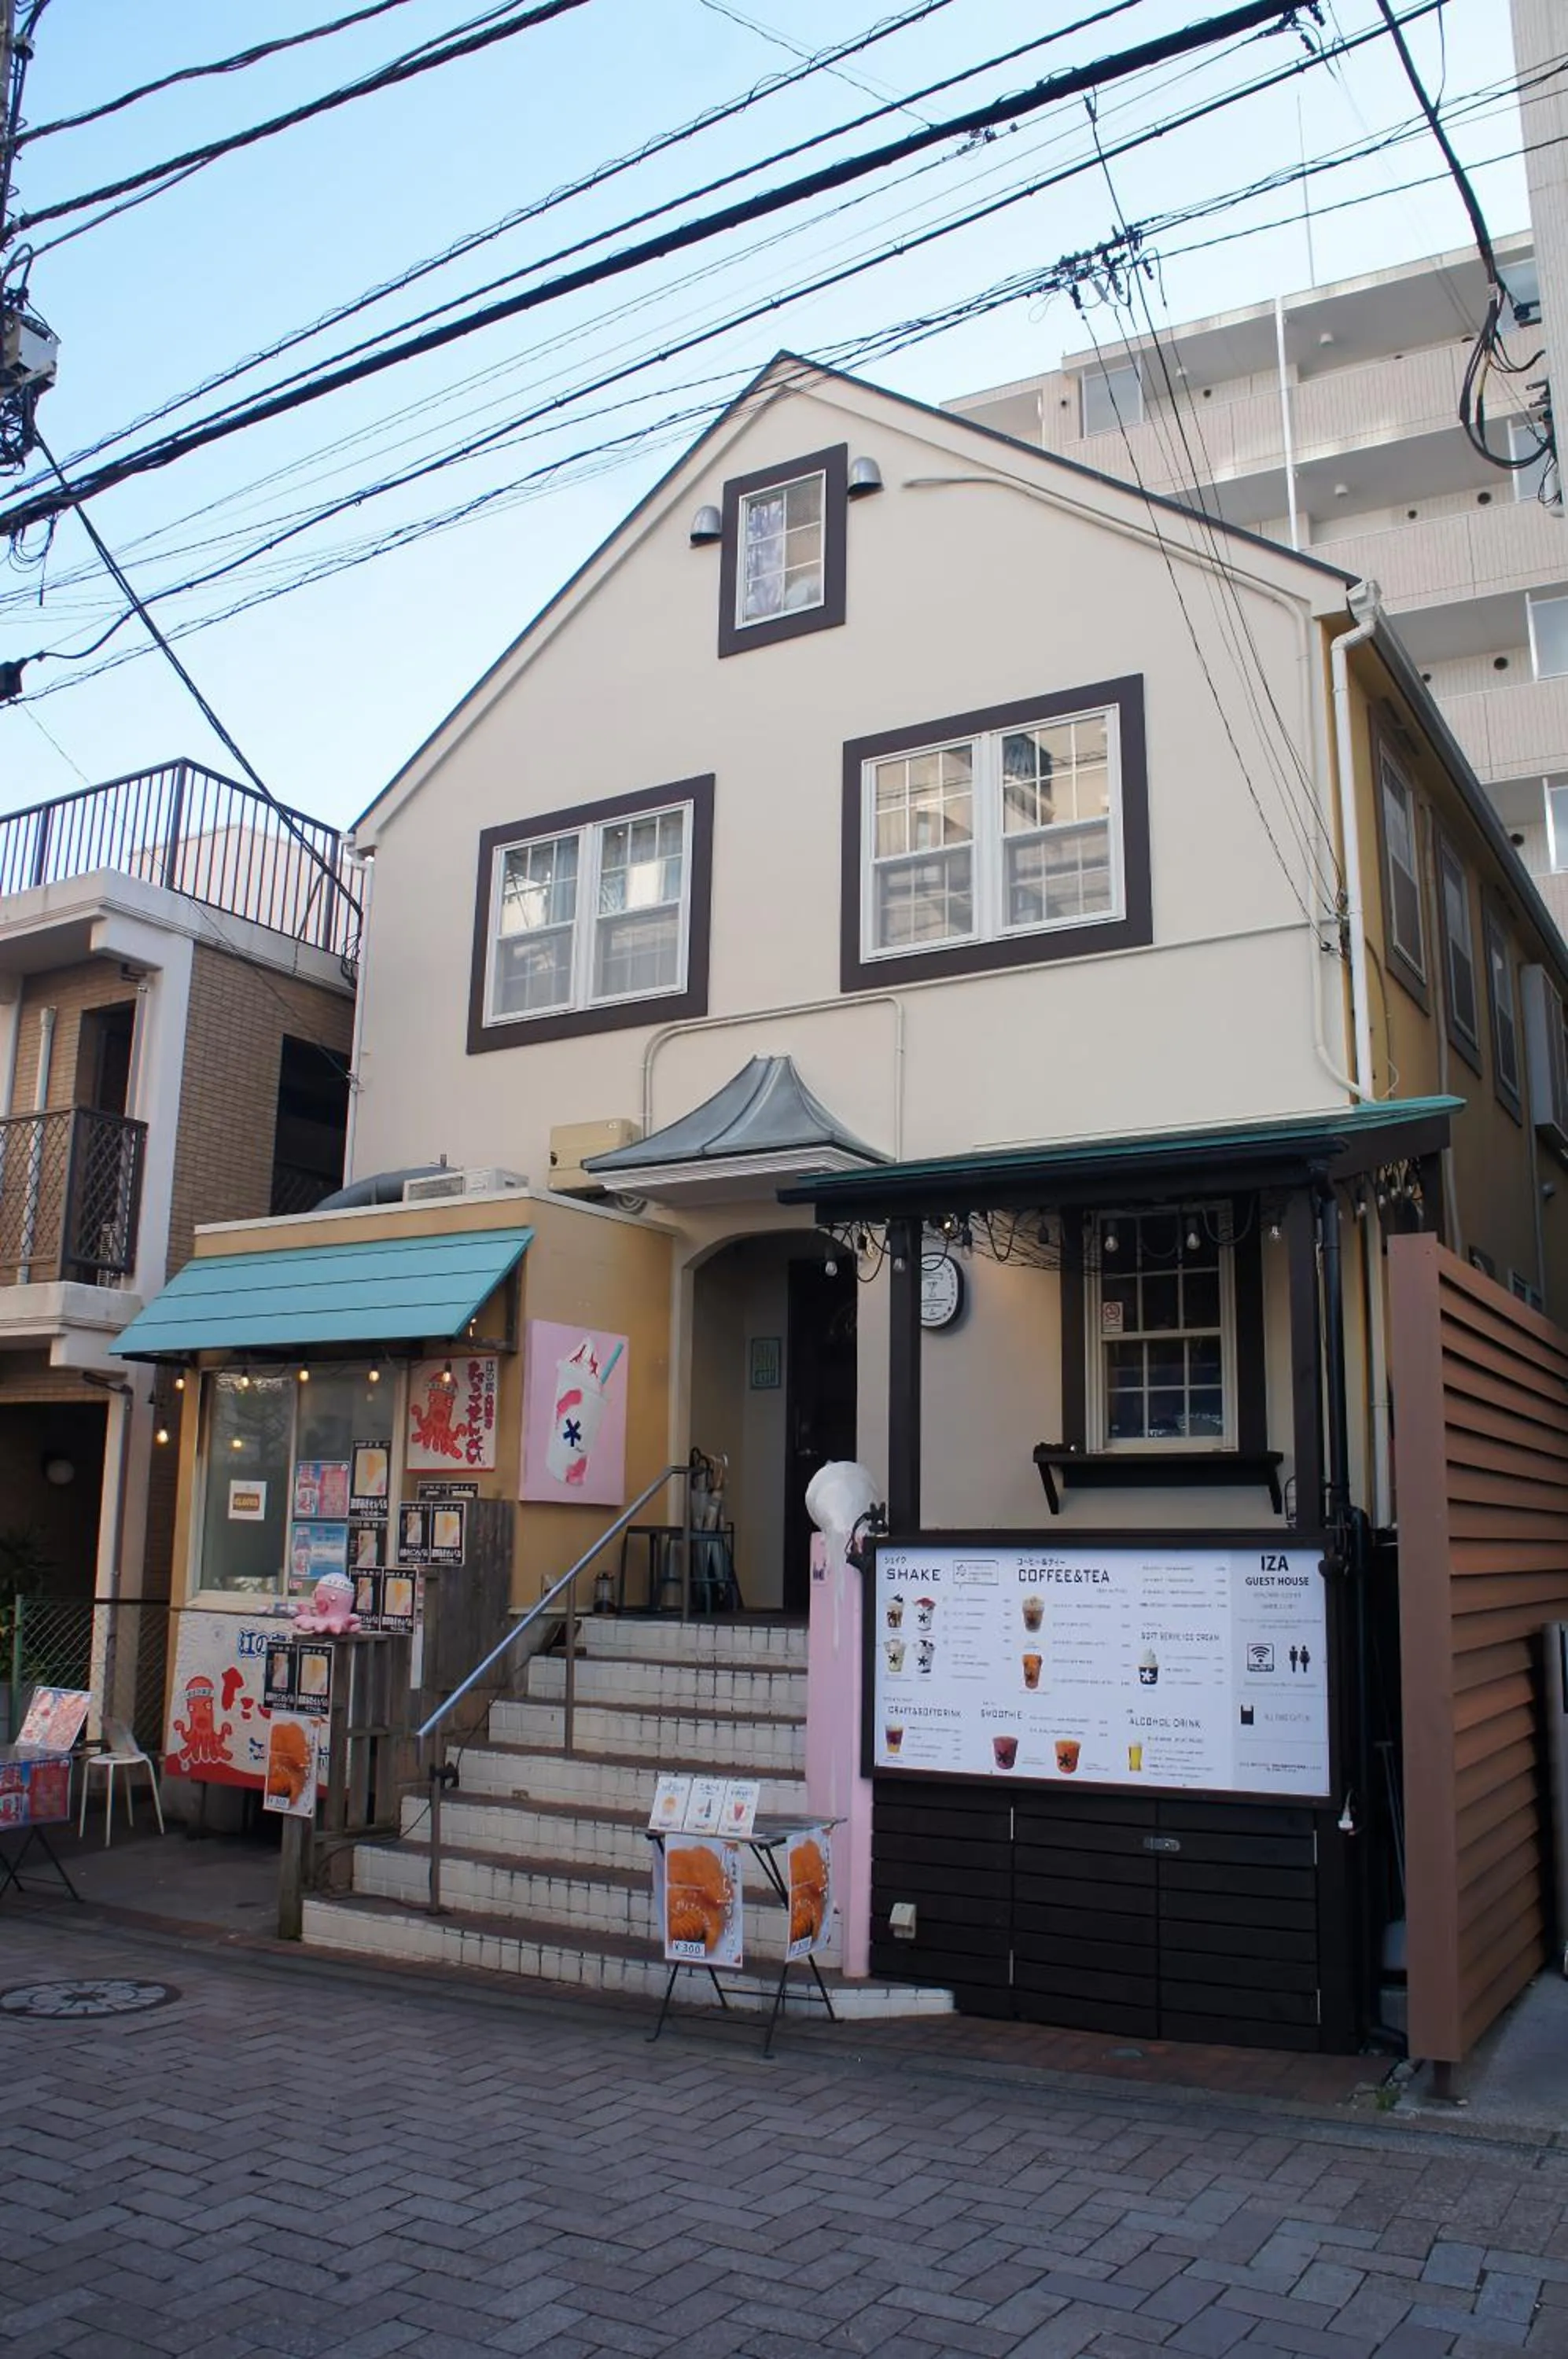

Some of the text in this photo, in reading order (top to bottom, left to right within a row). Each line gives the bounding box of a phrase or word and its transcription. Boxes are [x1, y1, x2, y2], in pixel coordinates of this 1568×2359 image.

[1261, 1555, 1289, 1572] IZA
[886, 1568, 941, 1581] SHAKE
[1018, 1568, 1110, 1583] COFFEE&TEA
[1245, 1577, 1309, 1586] GUEST HOUSE
